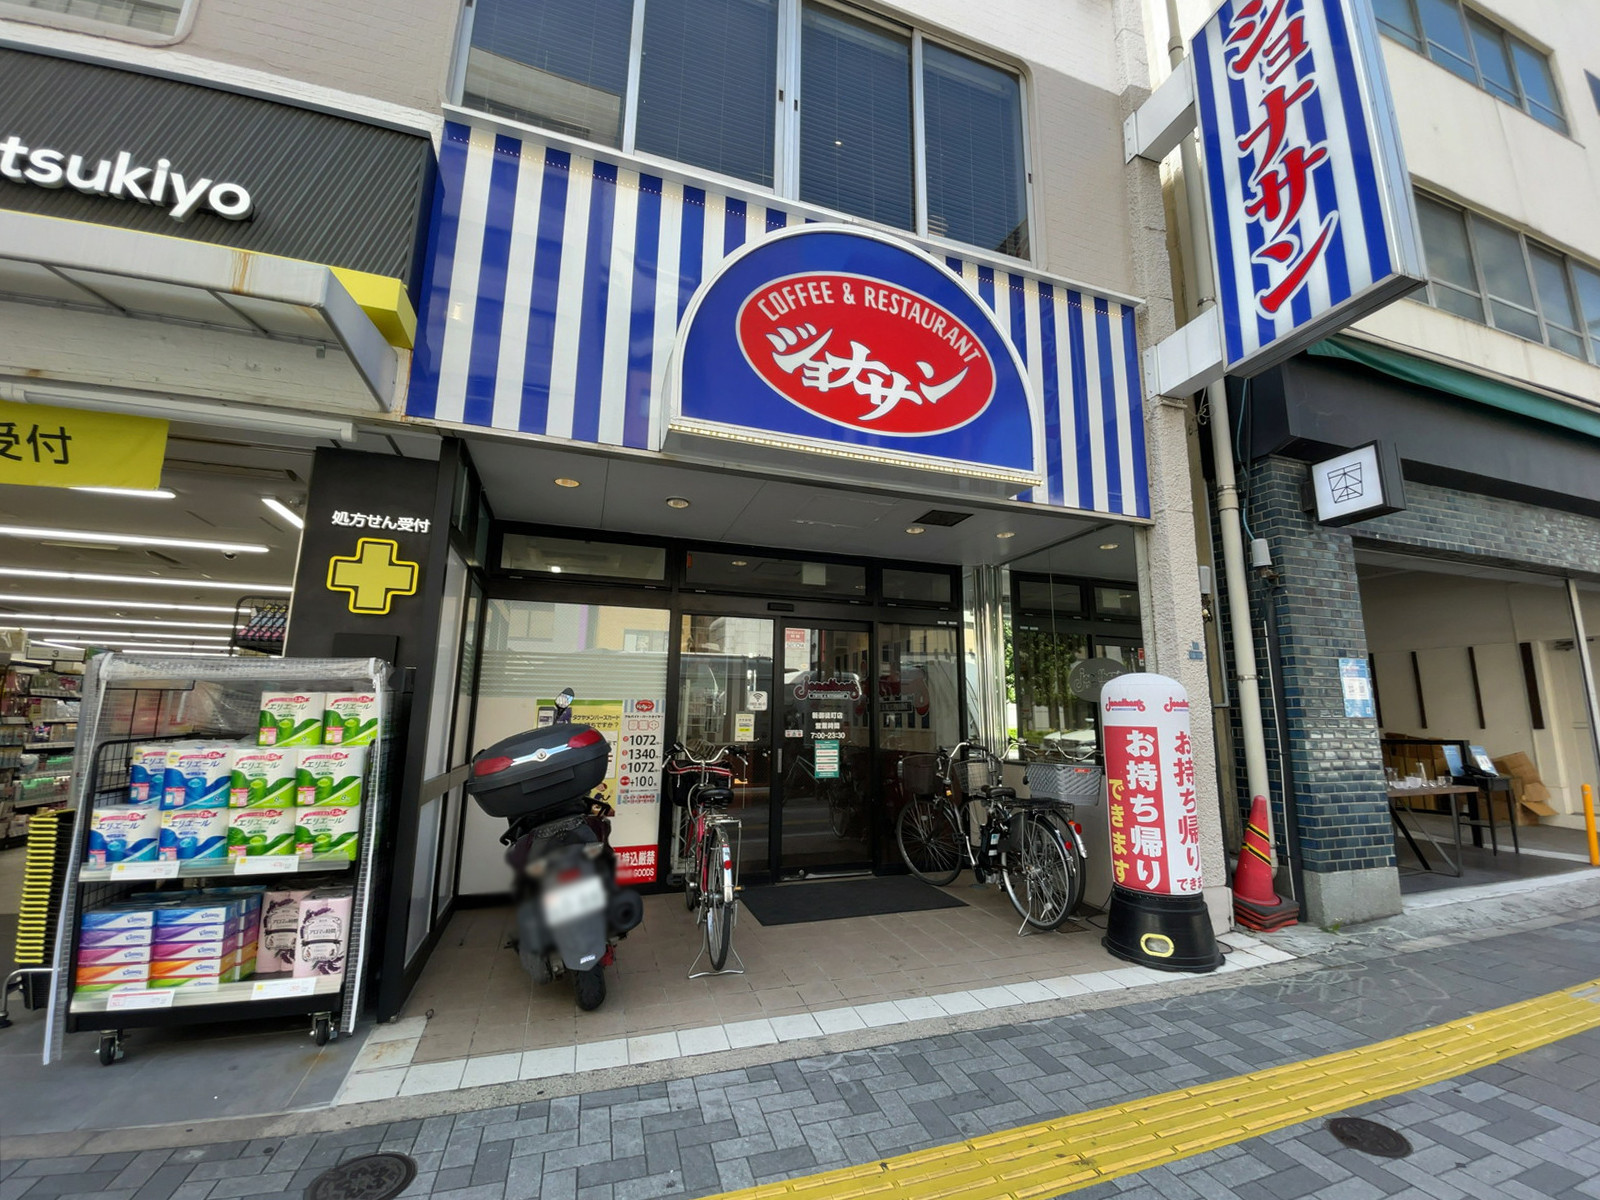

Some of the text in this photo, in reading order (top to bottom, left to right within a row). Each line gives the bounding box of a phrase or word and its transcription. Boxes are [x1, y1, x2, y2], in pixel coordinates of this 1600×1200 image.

[0, 136, 252, 222] tsukiyo
[757, 281, 982, 363] COFFEE & RESTAURANT
[765, 321, 969, 421] ジョナサン
[0, 422, 72, 465] 受付
[331, 510, 431, 534] 処方せん受付
[51, 649, 60, 658] 3
[629, 735, 656, 746] 1072
[628, 748, 656, 759] 1340
[174, 759, 221, 769] エリエール
[305, 760, 347, 769] エリエール
[627, 762, 655, 773] 1072
[1173, 730, 1202, 873] お持ち帰り
[1125, 729, 1164, 890] お持ち帰り
[96, 821, 141, 831] エリエール
[168, 819, 212, 829] エリエール
[236, 818, 281, 828] エリエール
[302, 816, 345, 826] エリエール
[1109, 778, 1130, 883] できます
